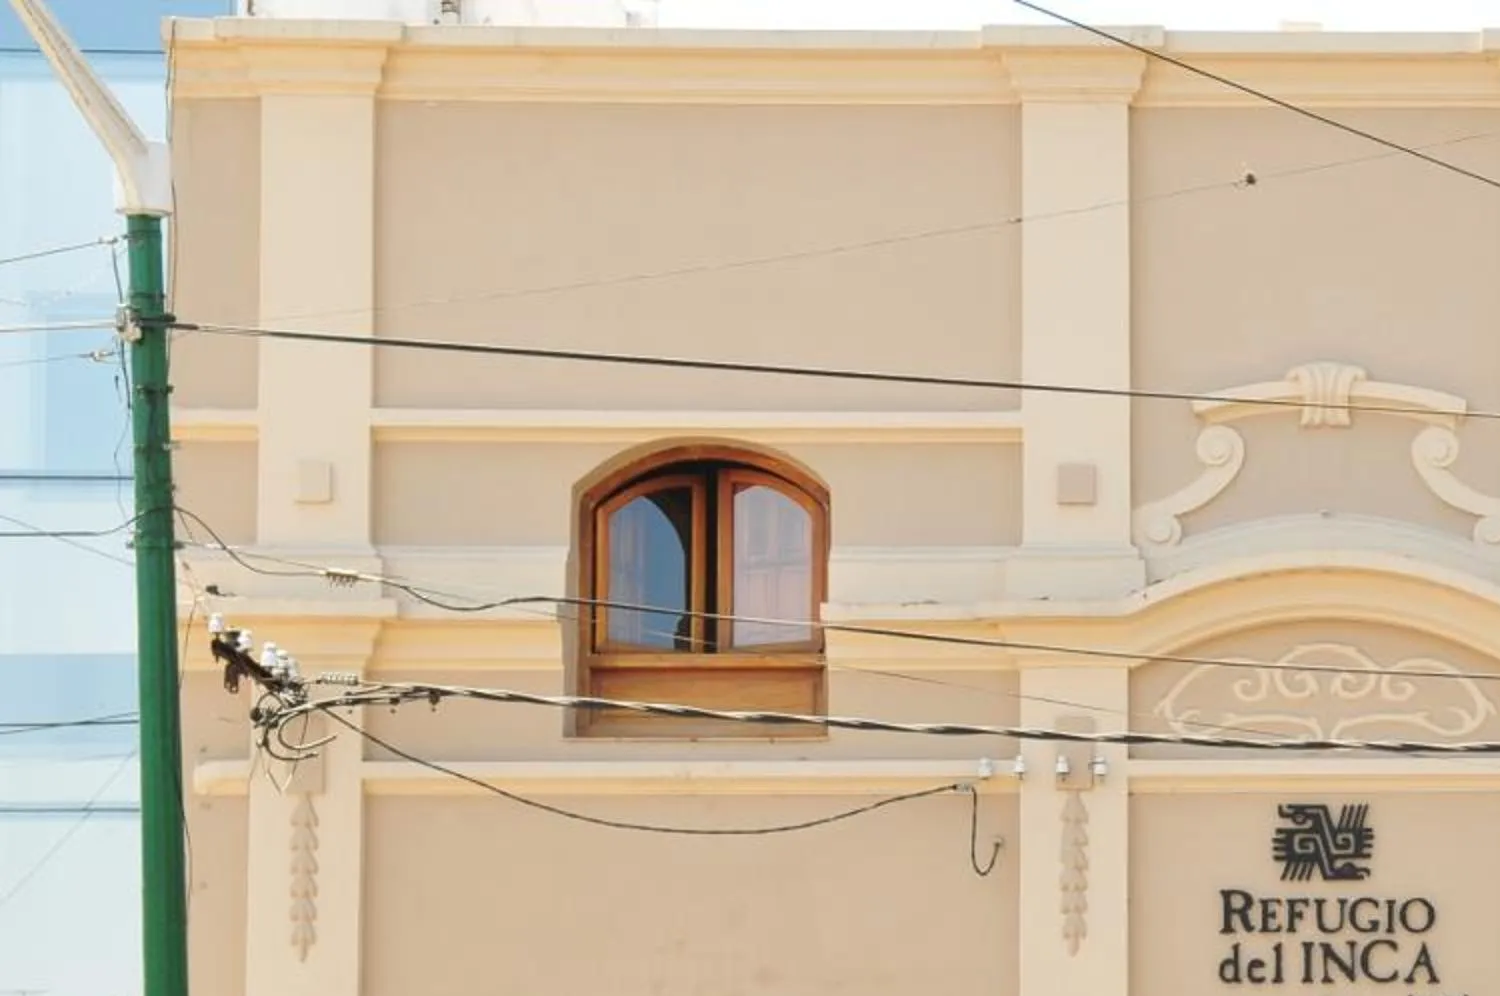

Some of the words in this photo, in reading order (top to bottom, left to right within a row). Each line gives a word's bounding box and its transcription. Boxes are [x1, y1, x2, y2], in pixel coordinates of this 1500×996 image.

[1218, 889, 1436, 935] REFUGIO
[1218, 942, 1284, 985] del
[1301, 939, 1441, 985] INCA
